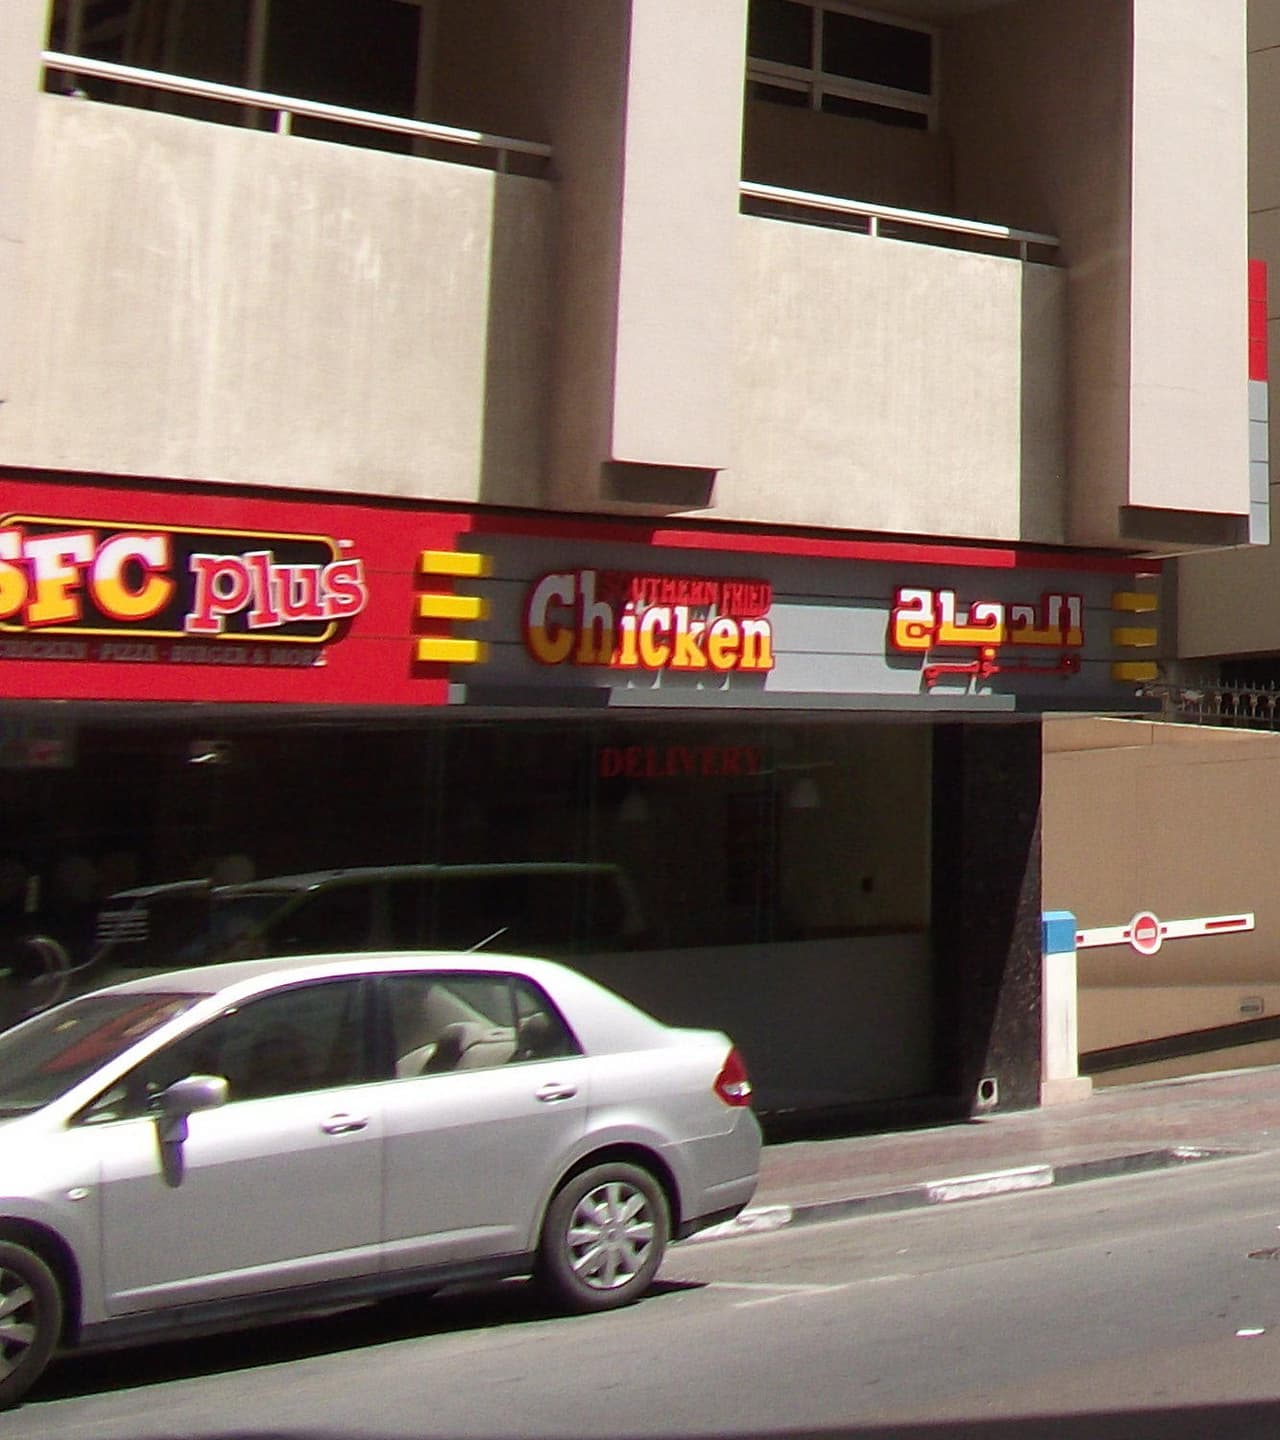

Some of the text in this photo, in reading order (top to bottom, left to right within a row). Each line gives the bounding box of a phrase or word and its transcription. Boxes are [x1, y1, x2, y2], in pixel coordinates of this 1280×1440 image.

[184, 550, 369, 635] plus
[527, 569, 776, 670] Chicken
[603, 573, 718, 606] UTHERN
[894, 586, 1084, 658] الدجاج
[599, 744, 764, 777] DELIVERY
